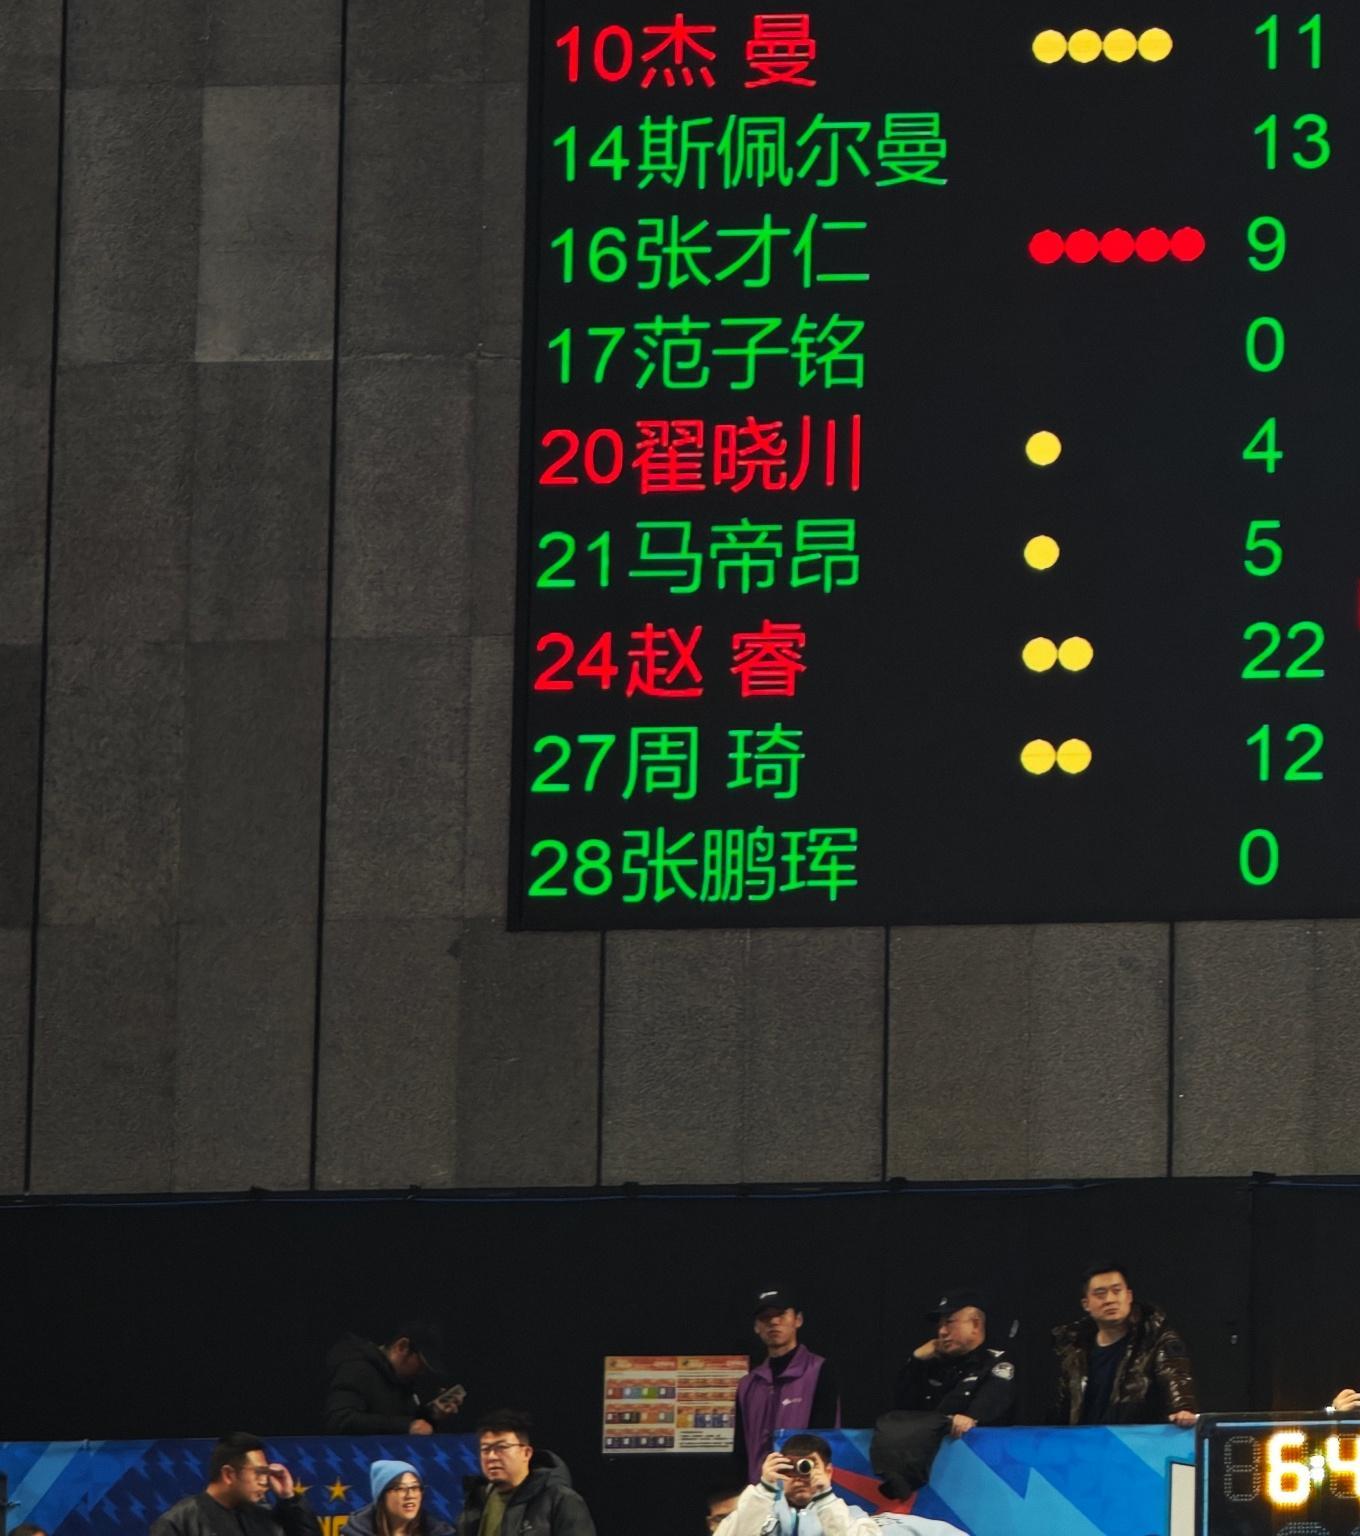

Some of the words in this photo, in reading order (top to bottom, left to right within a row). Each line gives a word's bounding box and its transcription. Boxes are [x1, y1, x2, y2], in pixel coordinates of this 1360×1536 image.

[1255, 13, 1321, 70] 11
[1254, 113, 1331, 170] 13
[1247, 215, 1286, 272] 9
[1245, 316, 1285, 373] 0
[1242, 417, 1283, 474] 4
[1244, 519, 1283, 577] 5
[1241, 620, 1325, 680] 22
[1246, 723, 1324, 782] 12
[1239, 828, 1279, 886] 0
